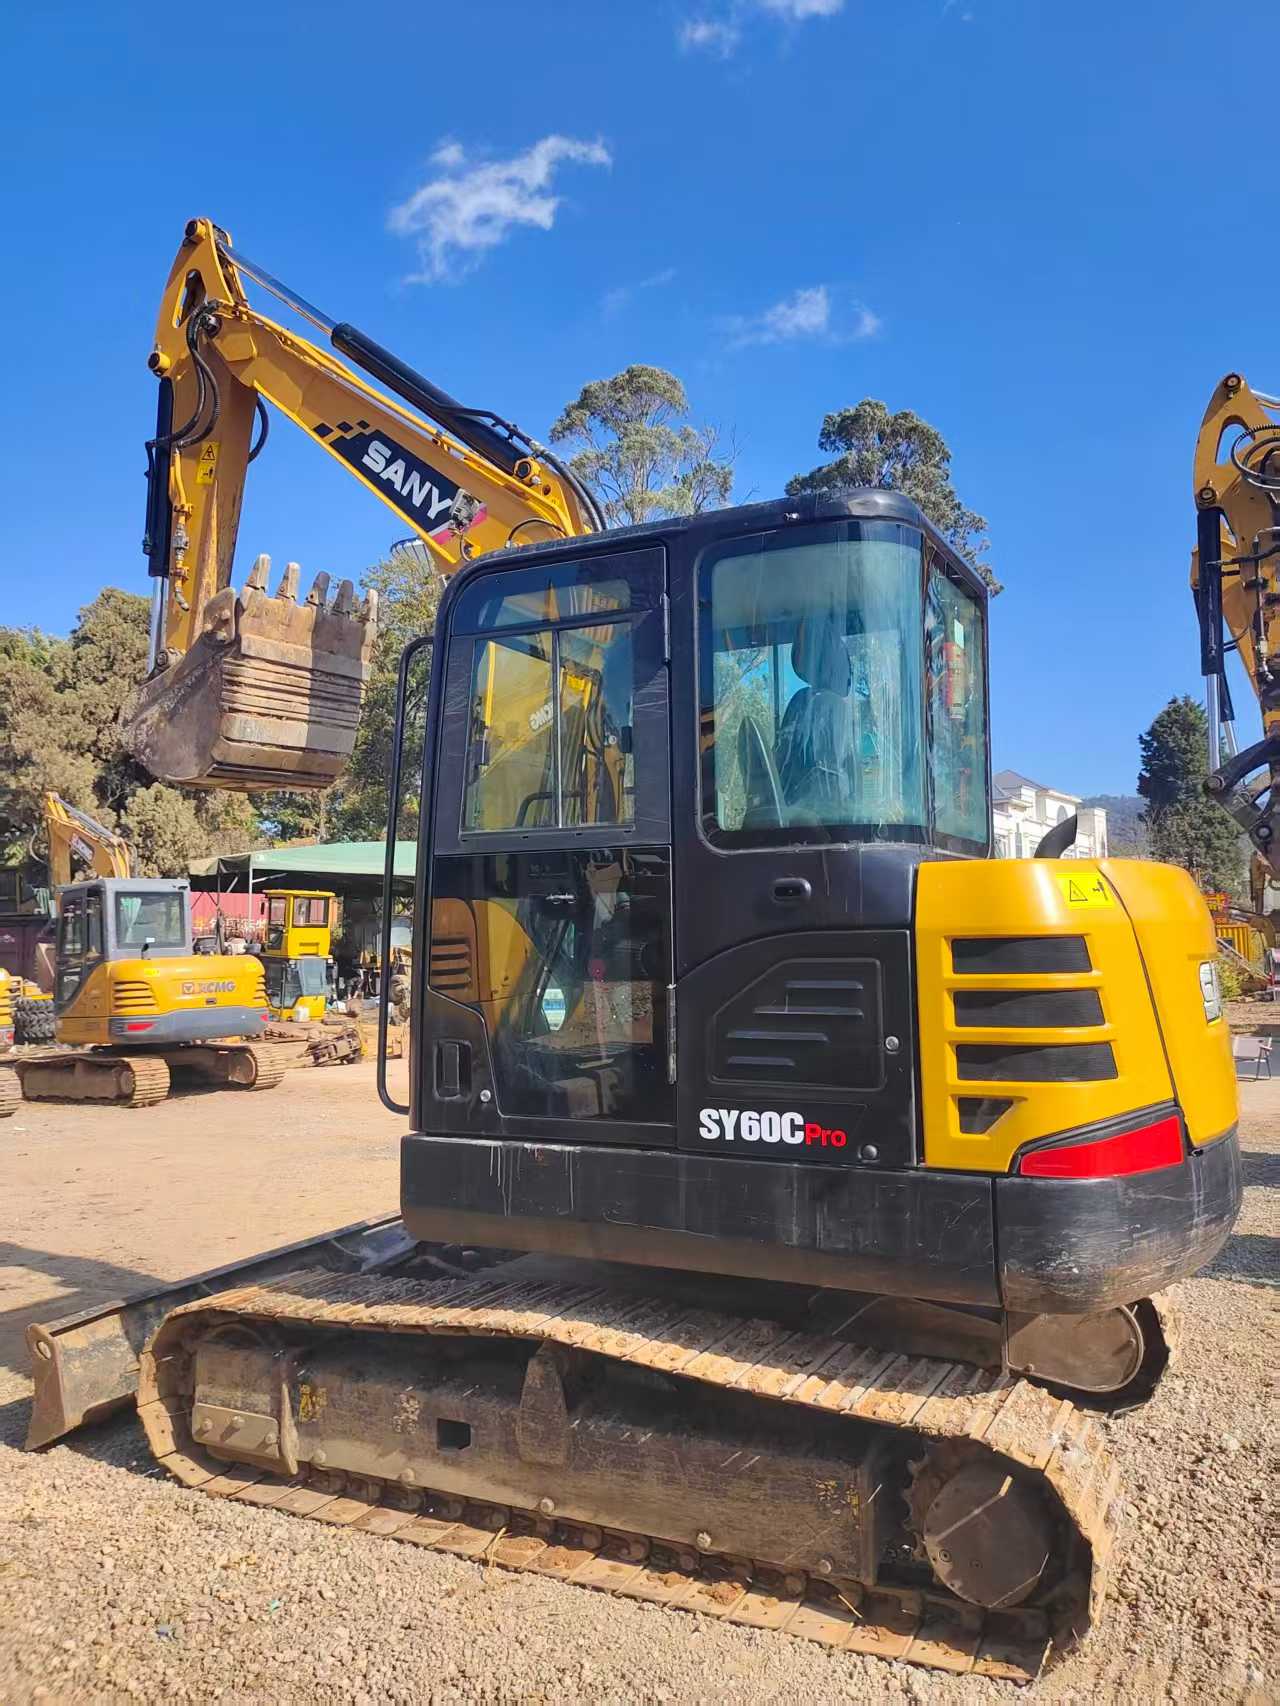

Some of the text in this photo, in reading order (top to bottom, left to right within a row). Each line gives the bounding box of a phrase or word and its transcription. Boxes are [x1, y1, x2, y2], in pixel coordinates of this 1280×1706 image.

[361, 440, 453, 520] SANY
[699, 1108, 847, 1147] SY60C Pro
